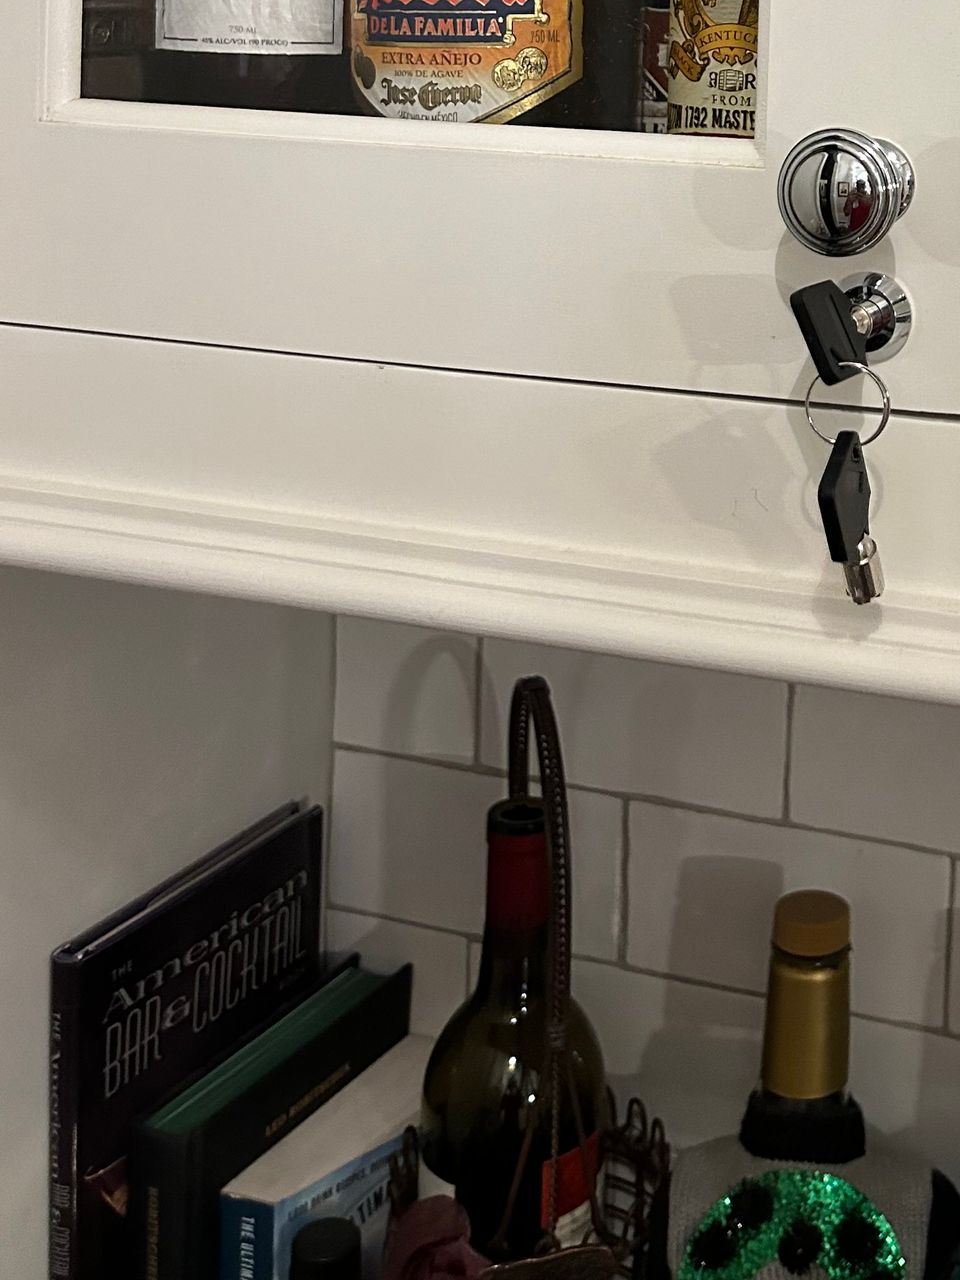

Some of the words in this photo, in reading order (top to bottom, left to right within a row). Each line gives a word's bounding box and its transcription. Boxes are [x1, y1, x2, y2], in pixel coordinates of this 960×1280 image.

[381, 52, 426, 66] EXTRA
[429, 49, 482, 66] AÑEJO
[394, 70, 413, 79] 100%
[415, 71, 428, 79] DE
[430, 71, 464, 80] AGAVE
[418, 80, 482, 111] Cuervo
[711, 94, 752, 107] FROM
[684, 105, 708, 129] 1792
[102, 869, 309, 1025] American
[111, 959, 133, 982] THE
[102, 995, 163, 1100] BAR
[192, 896, 308, 1035] COCKTAIL
[240, 1216, 256, 1241] THE
